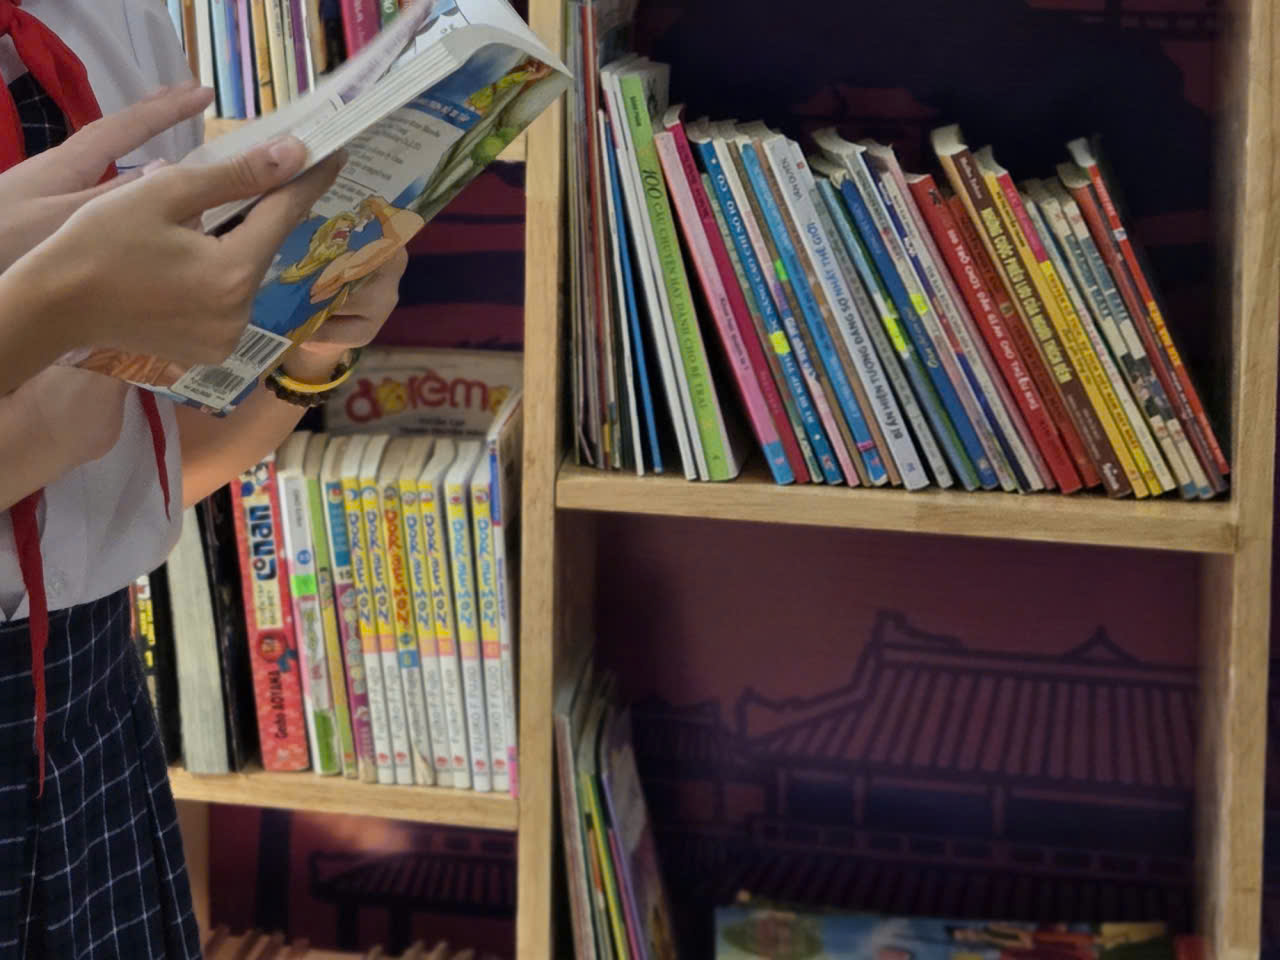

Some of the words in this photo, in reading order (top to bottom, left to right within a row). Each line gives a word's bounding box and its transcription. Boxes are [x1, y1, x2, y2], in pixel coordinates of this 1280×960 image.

[641, 166, 663, 200] 100
[658, 228, 678, 274] CHUYỆN
[669, 276, 684, 300] HAY
[683, 337, 698, 366] CHO
[842, 310, 864, 346] ĐÁNG
[986, 313, 1004, 338] GIAN
[998, 339, 1014, 360] CHO
[855, 344, 880, 385] TƯỢNG
[871, 383, 891, 412] HIỆN
